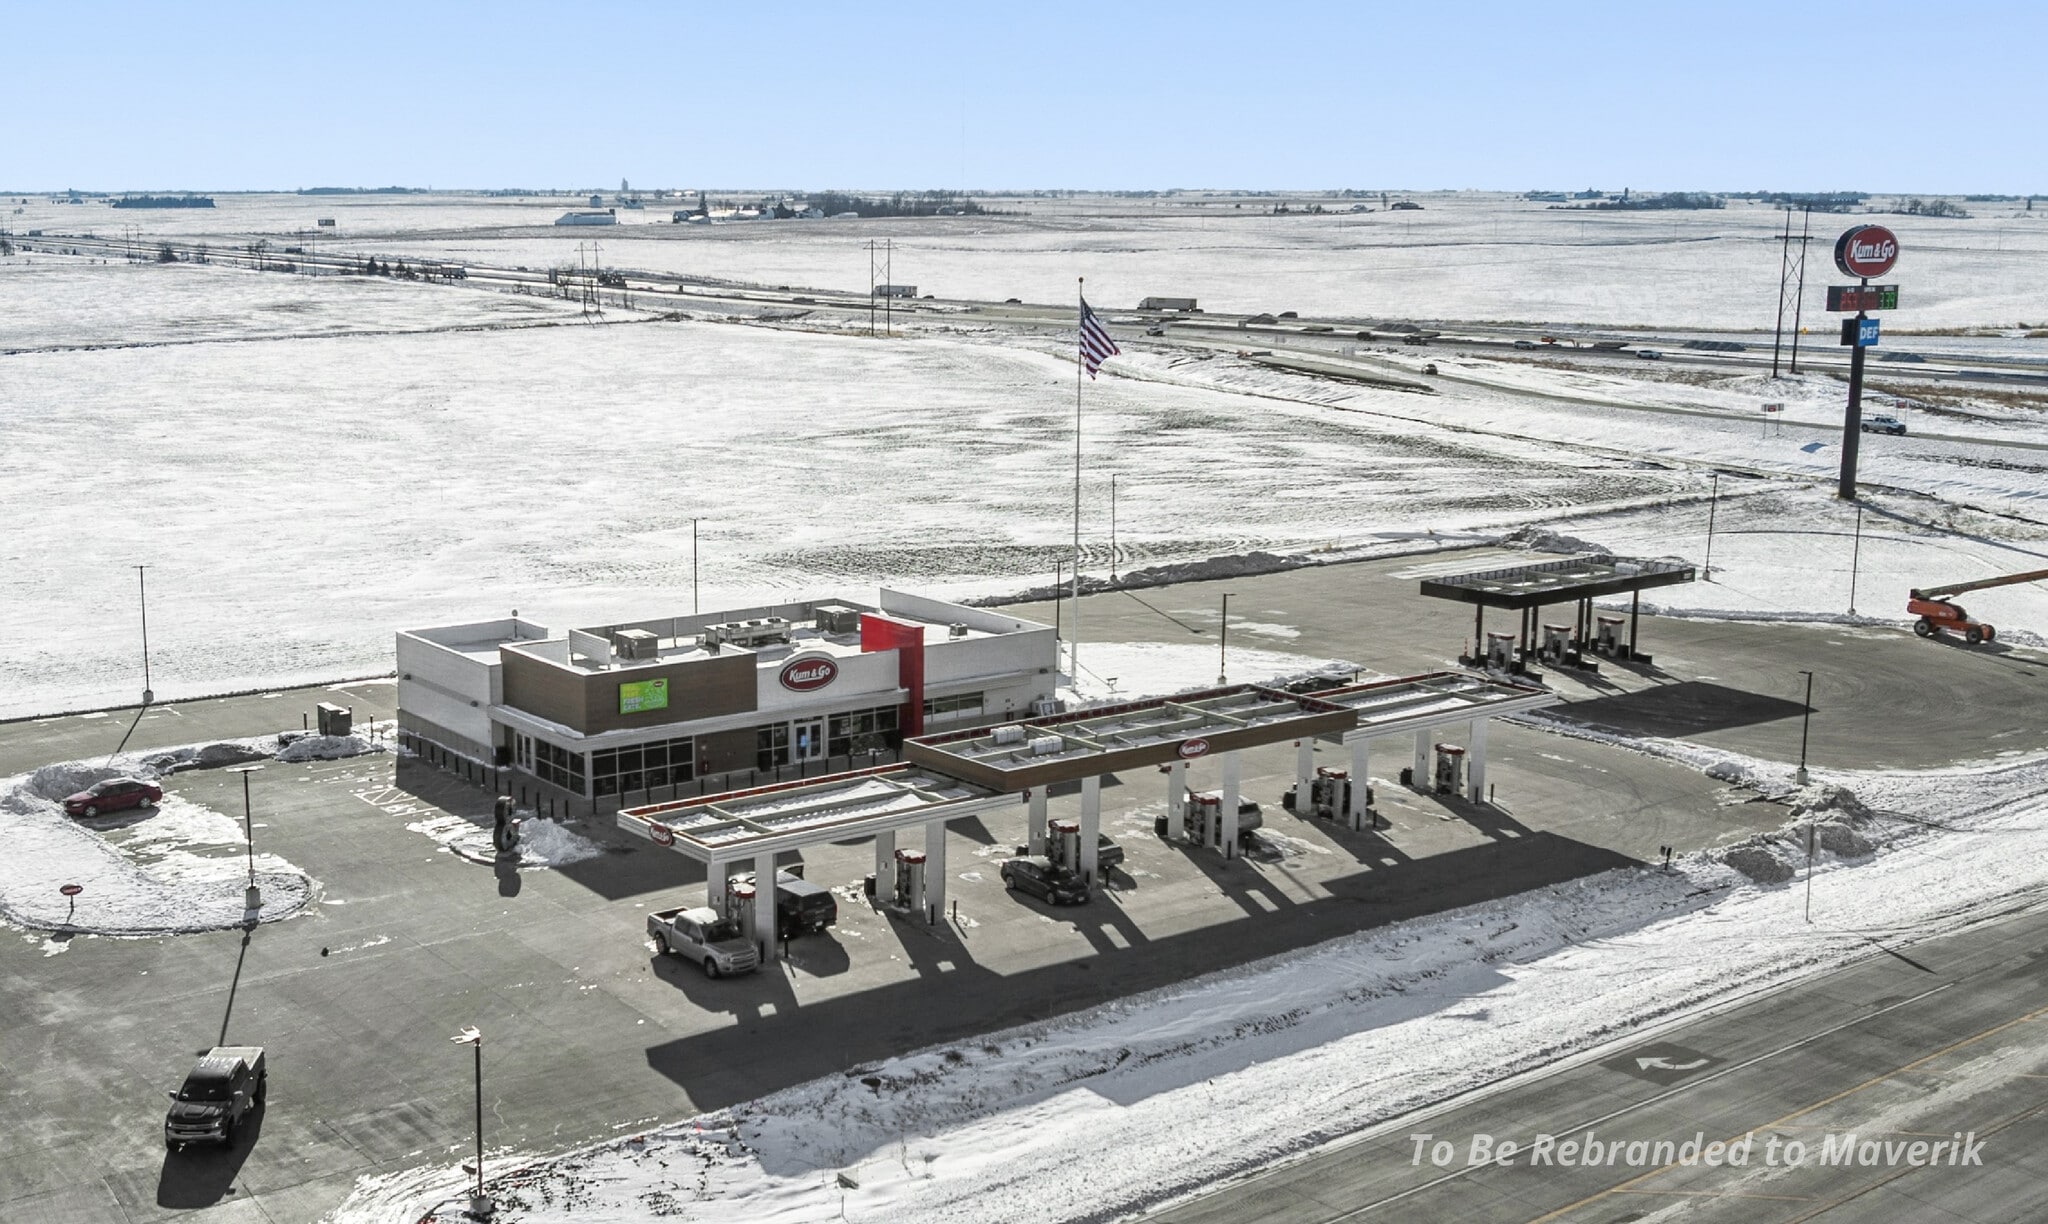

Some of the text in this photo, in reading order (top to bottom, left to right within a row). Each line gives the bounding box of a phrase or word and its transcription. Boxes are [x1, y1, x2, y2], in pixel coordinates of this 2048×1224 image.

[1850, 239, 1895, 260] Kum & Go
[1860, 326, 1878, 340] DEF
[789, 665, 831, 682] Kum & Go
